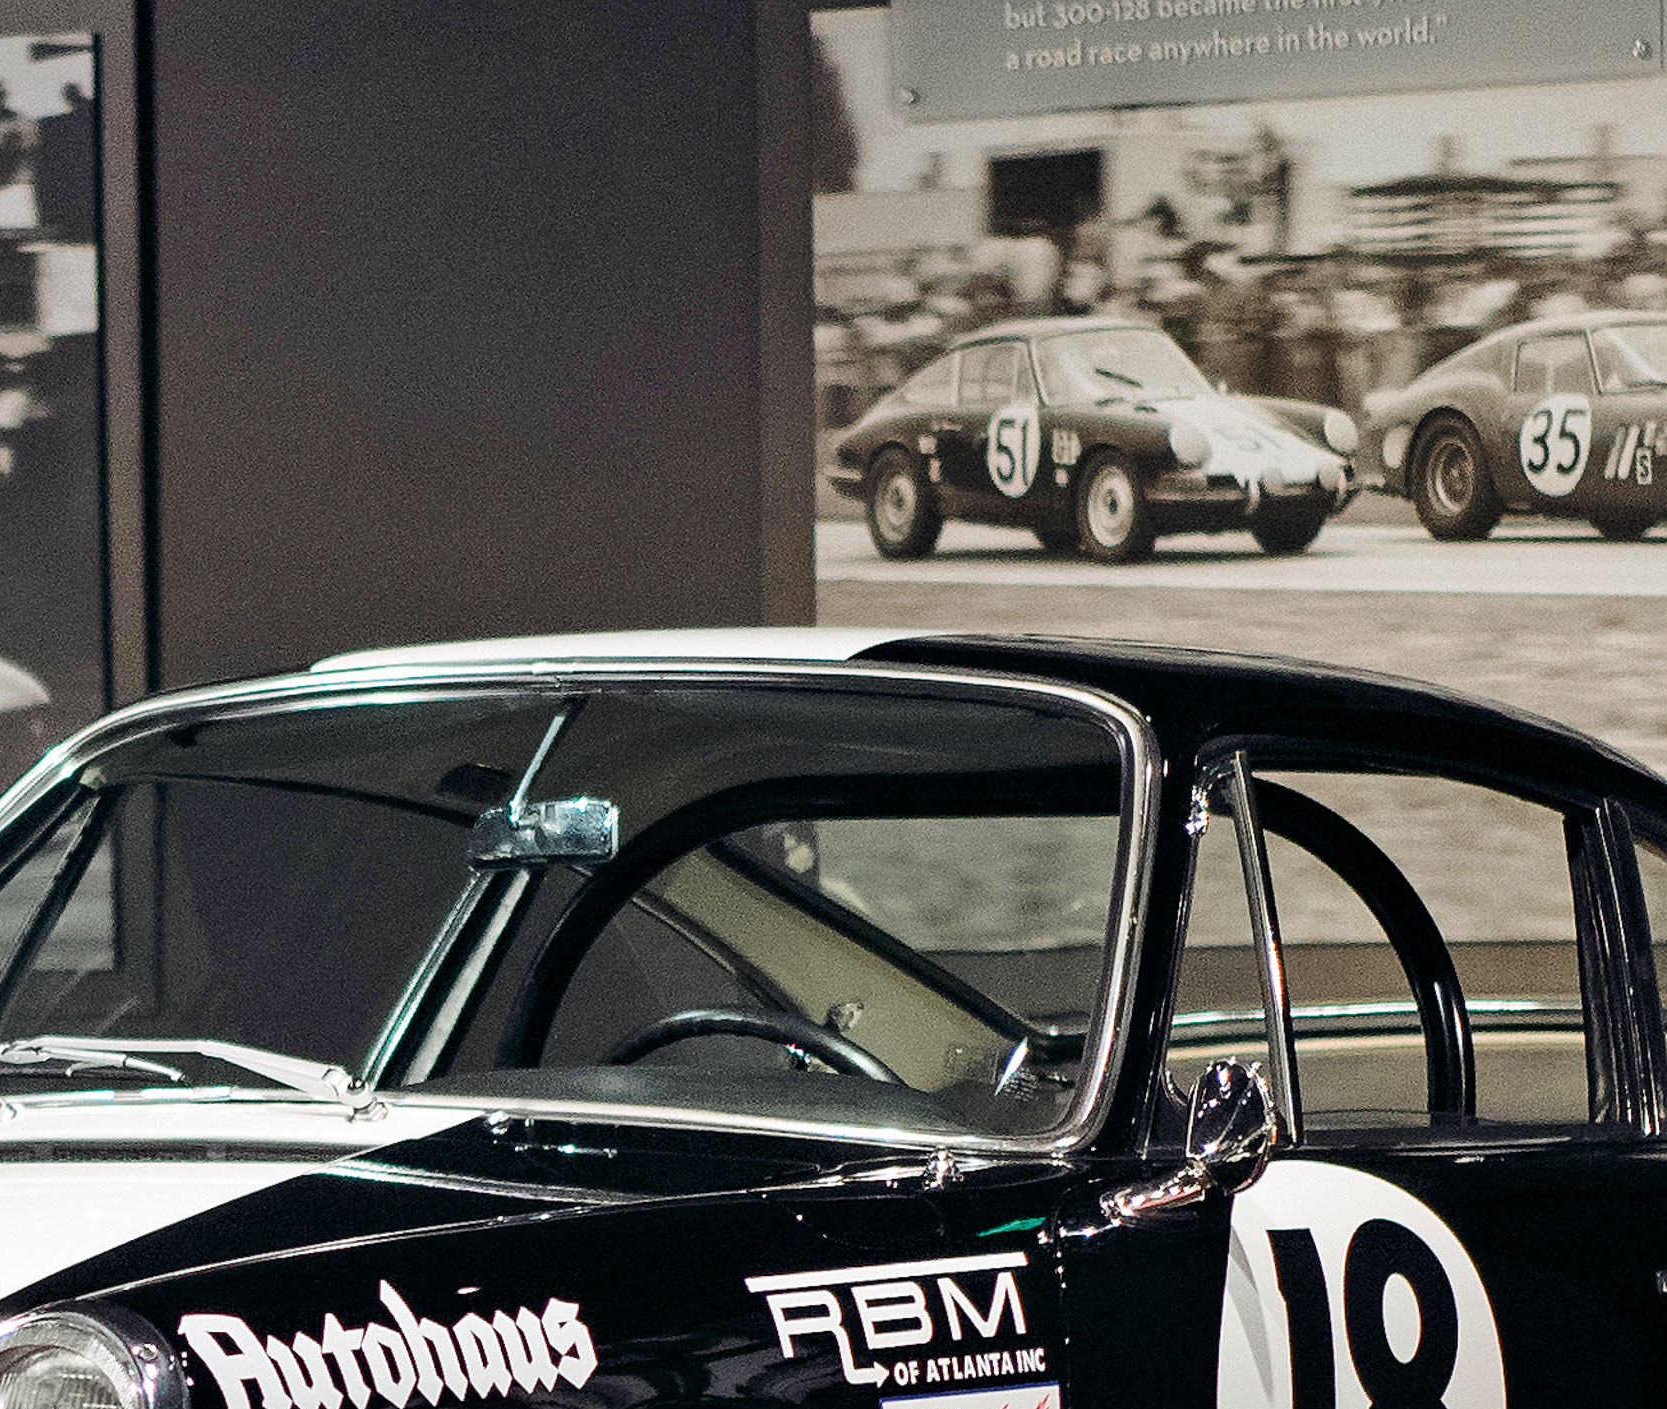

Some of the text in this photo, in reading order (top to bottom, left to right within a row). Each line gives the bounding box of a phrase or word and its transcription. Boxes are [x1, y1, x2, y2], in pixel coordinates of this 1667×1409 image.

[1005, 2, 1047, 29] but
[1158, 0, 1255, 17] became
[1005, 52, 1020, 70] a
[1025, 40, 1082, 68] road
[1088, 43, 1143, 66] race
[1149, 30, 1271, 66] anywhere
[1277, 26, 1301, 52] in
[1308, 22, 1350, 50] the
[994, 416, 1032, 485] 51
[1527, 408, 1587, 476] 35
[766, 1270, 1028, 1386] RBM
[893, 1347, 1046, 1386] OF ATLANTA INC
